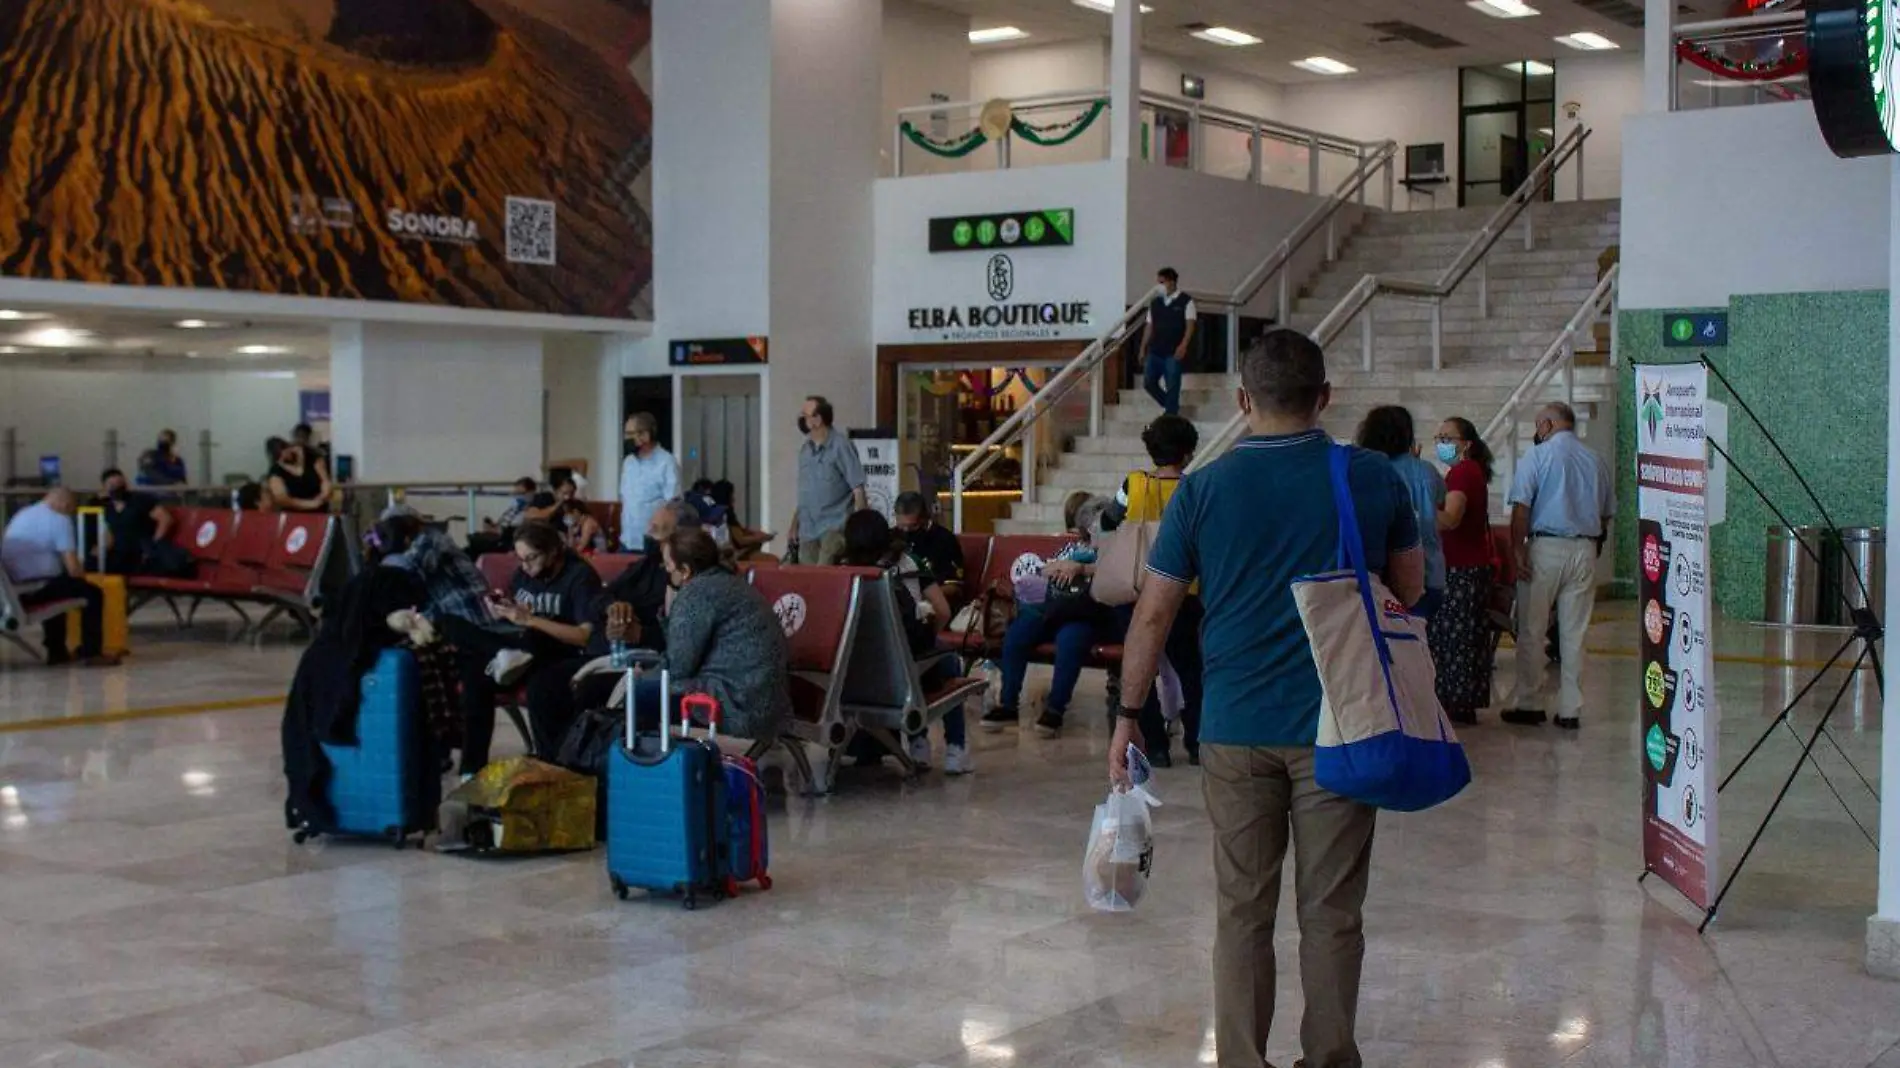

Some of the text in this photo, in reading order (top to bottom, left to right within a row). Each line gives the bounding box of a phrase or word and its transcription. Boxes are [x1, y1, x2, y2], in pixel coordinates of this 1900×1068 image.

[387, 207, 479, 240] SONORA
[908, 302, 1090, 330] ELBA BOUTIQUE
[867, 446, 879, 459] YA
